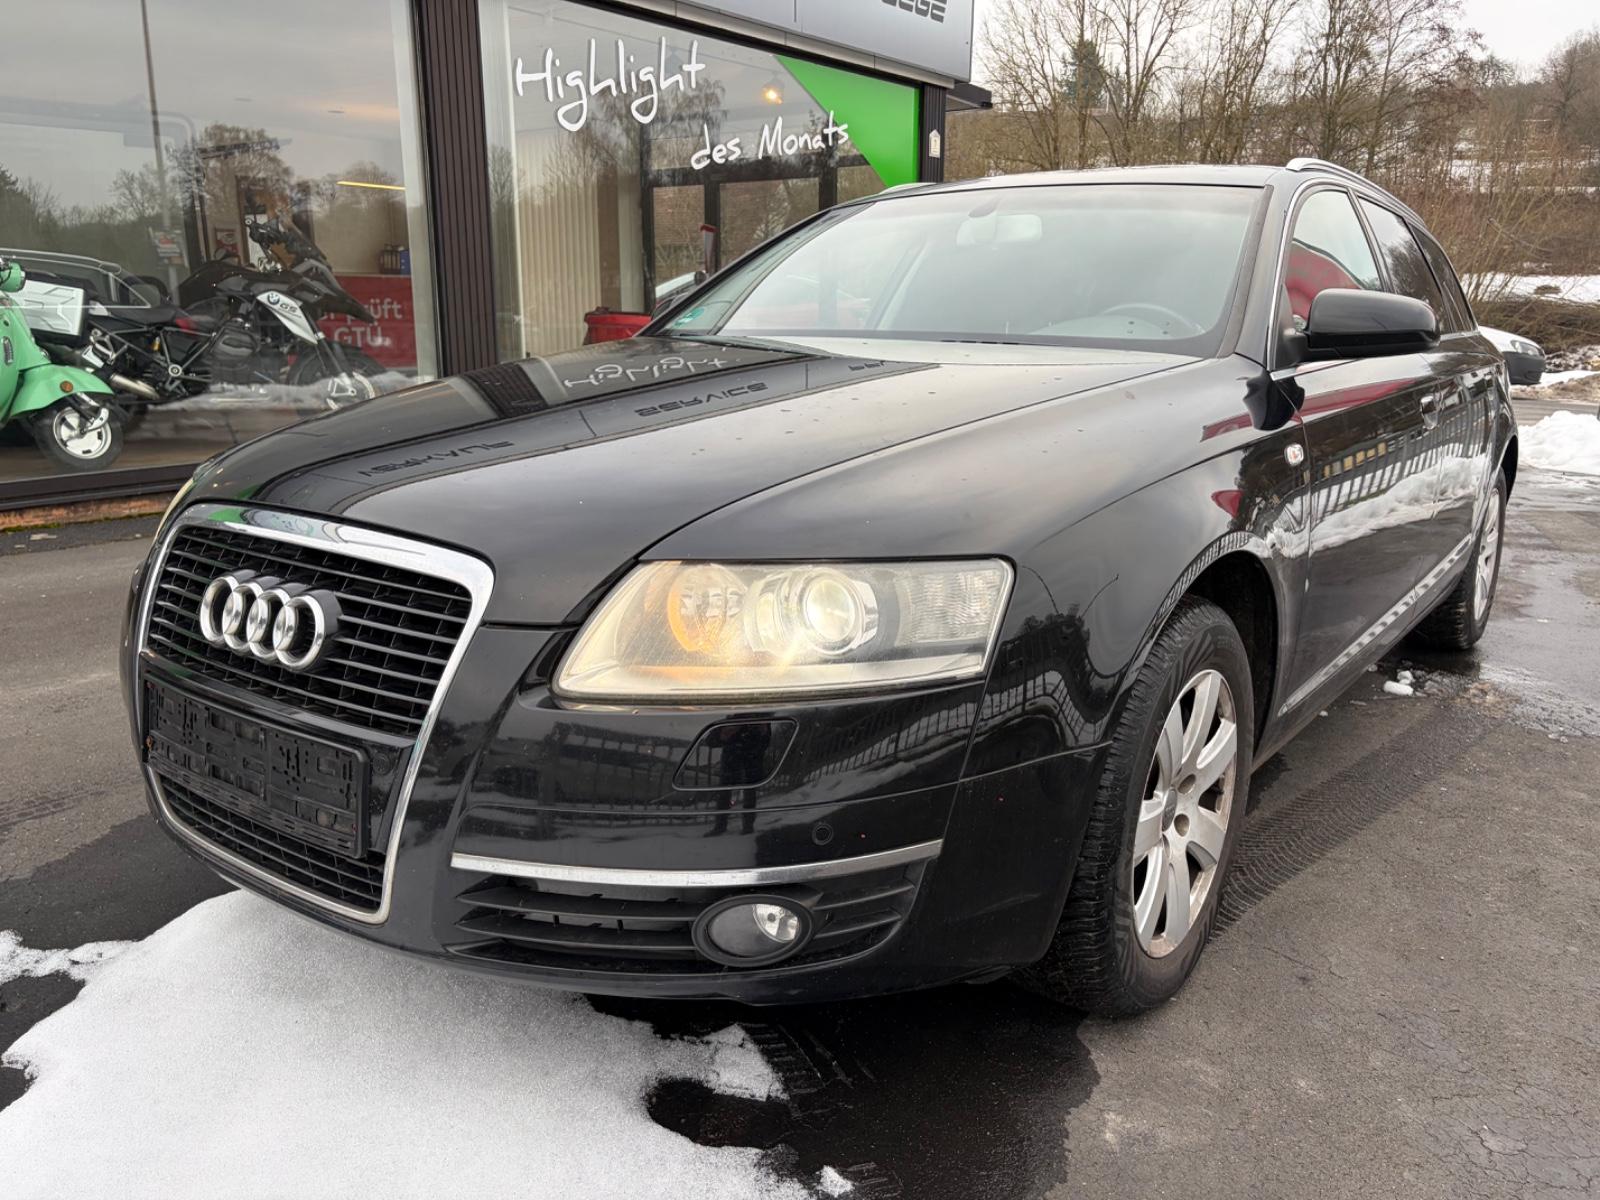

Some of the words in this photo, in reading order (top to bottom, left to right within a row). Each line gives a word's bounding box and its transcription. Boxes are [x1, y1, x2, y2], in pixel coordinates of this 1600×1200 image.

[881, 0, 948, 24] GE
[515, 36, 706, 132] Highlight
[690, 123, 741, 171] des
[758, 110, 850, 160] Monats
[280, 302, 298, 313] GS
